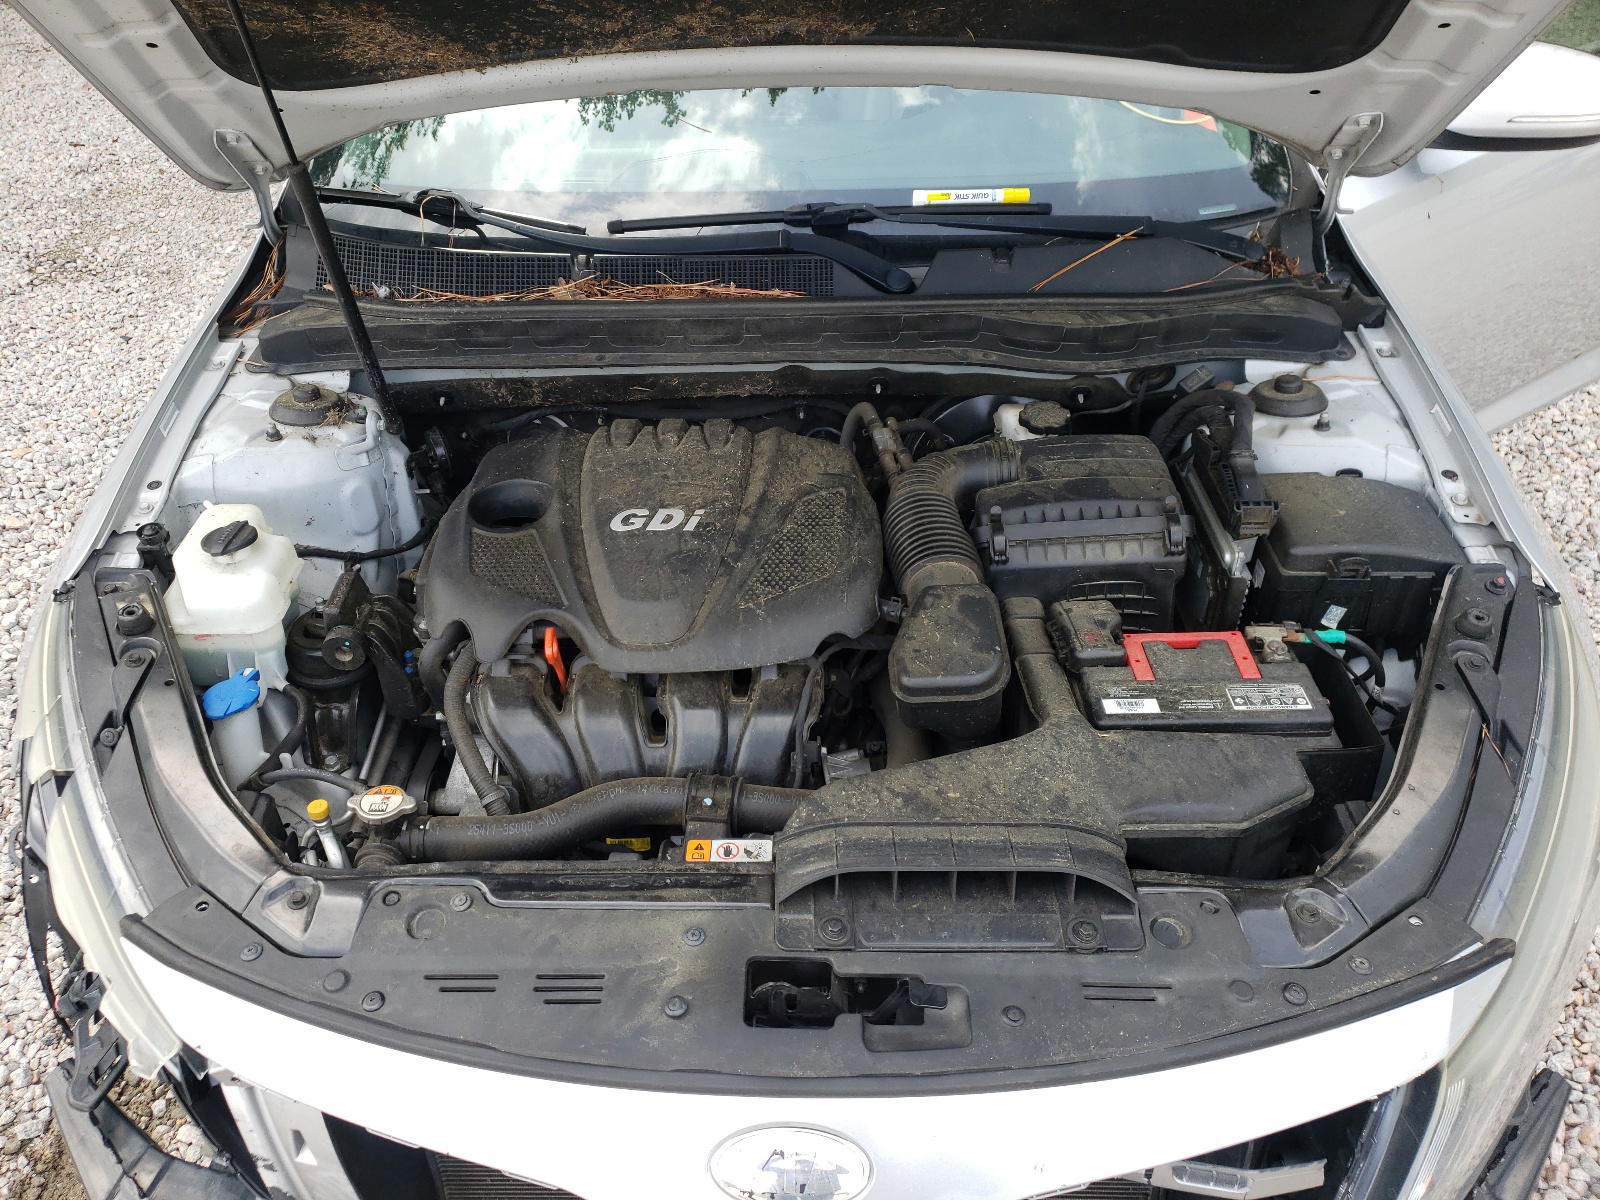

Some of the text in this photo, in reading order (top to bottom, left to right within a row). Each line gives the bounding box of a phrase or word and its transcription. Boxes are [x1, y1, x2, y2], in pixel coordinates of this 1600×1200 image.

[953, 192, 970, 201] STIK
[970, 192, 990, 201] QUIK
[609, 508, 706, 532] GDi
